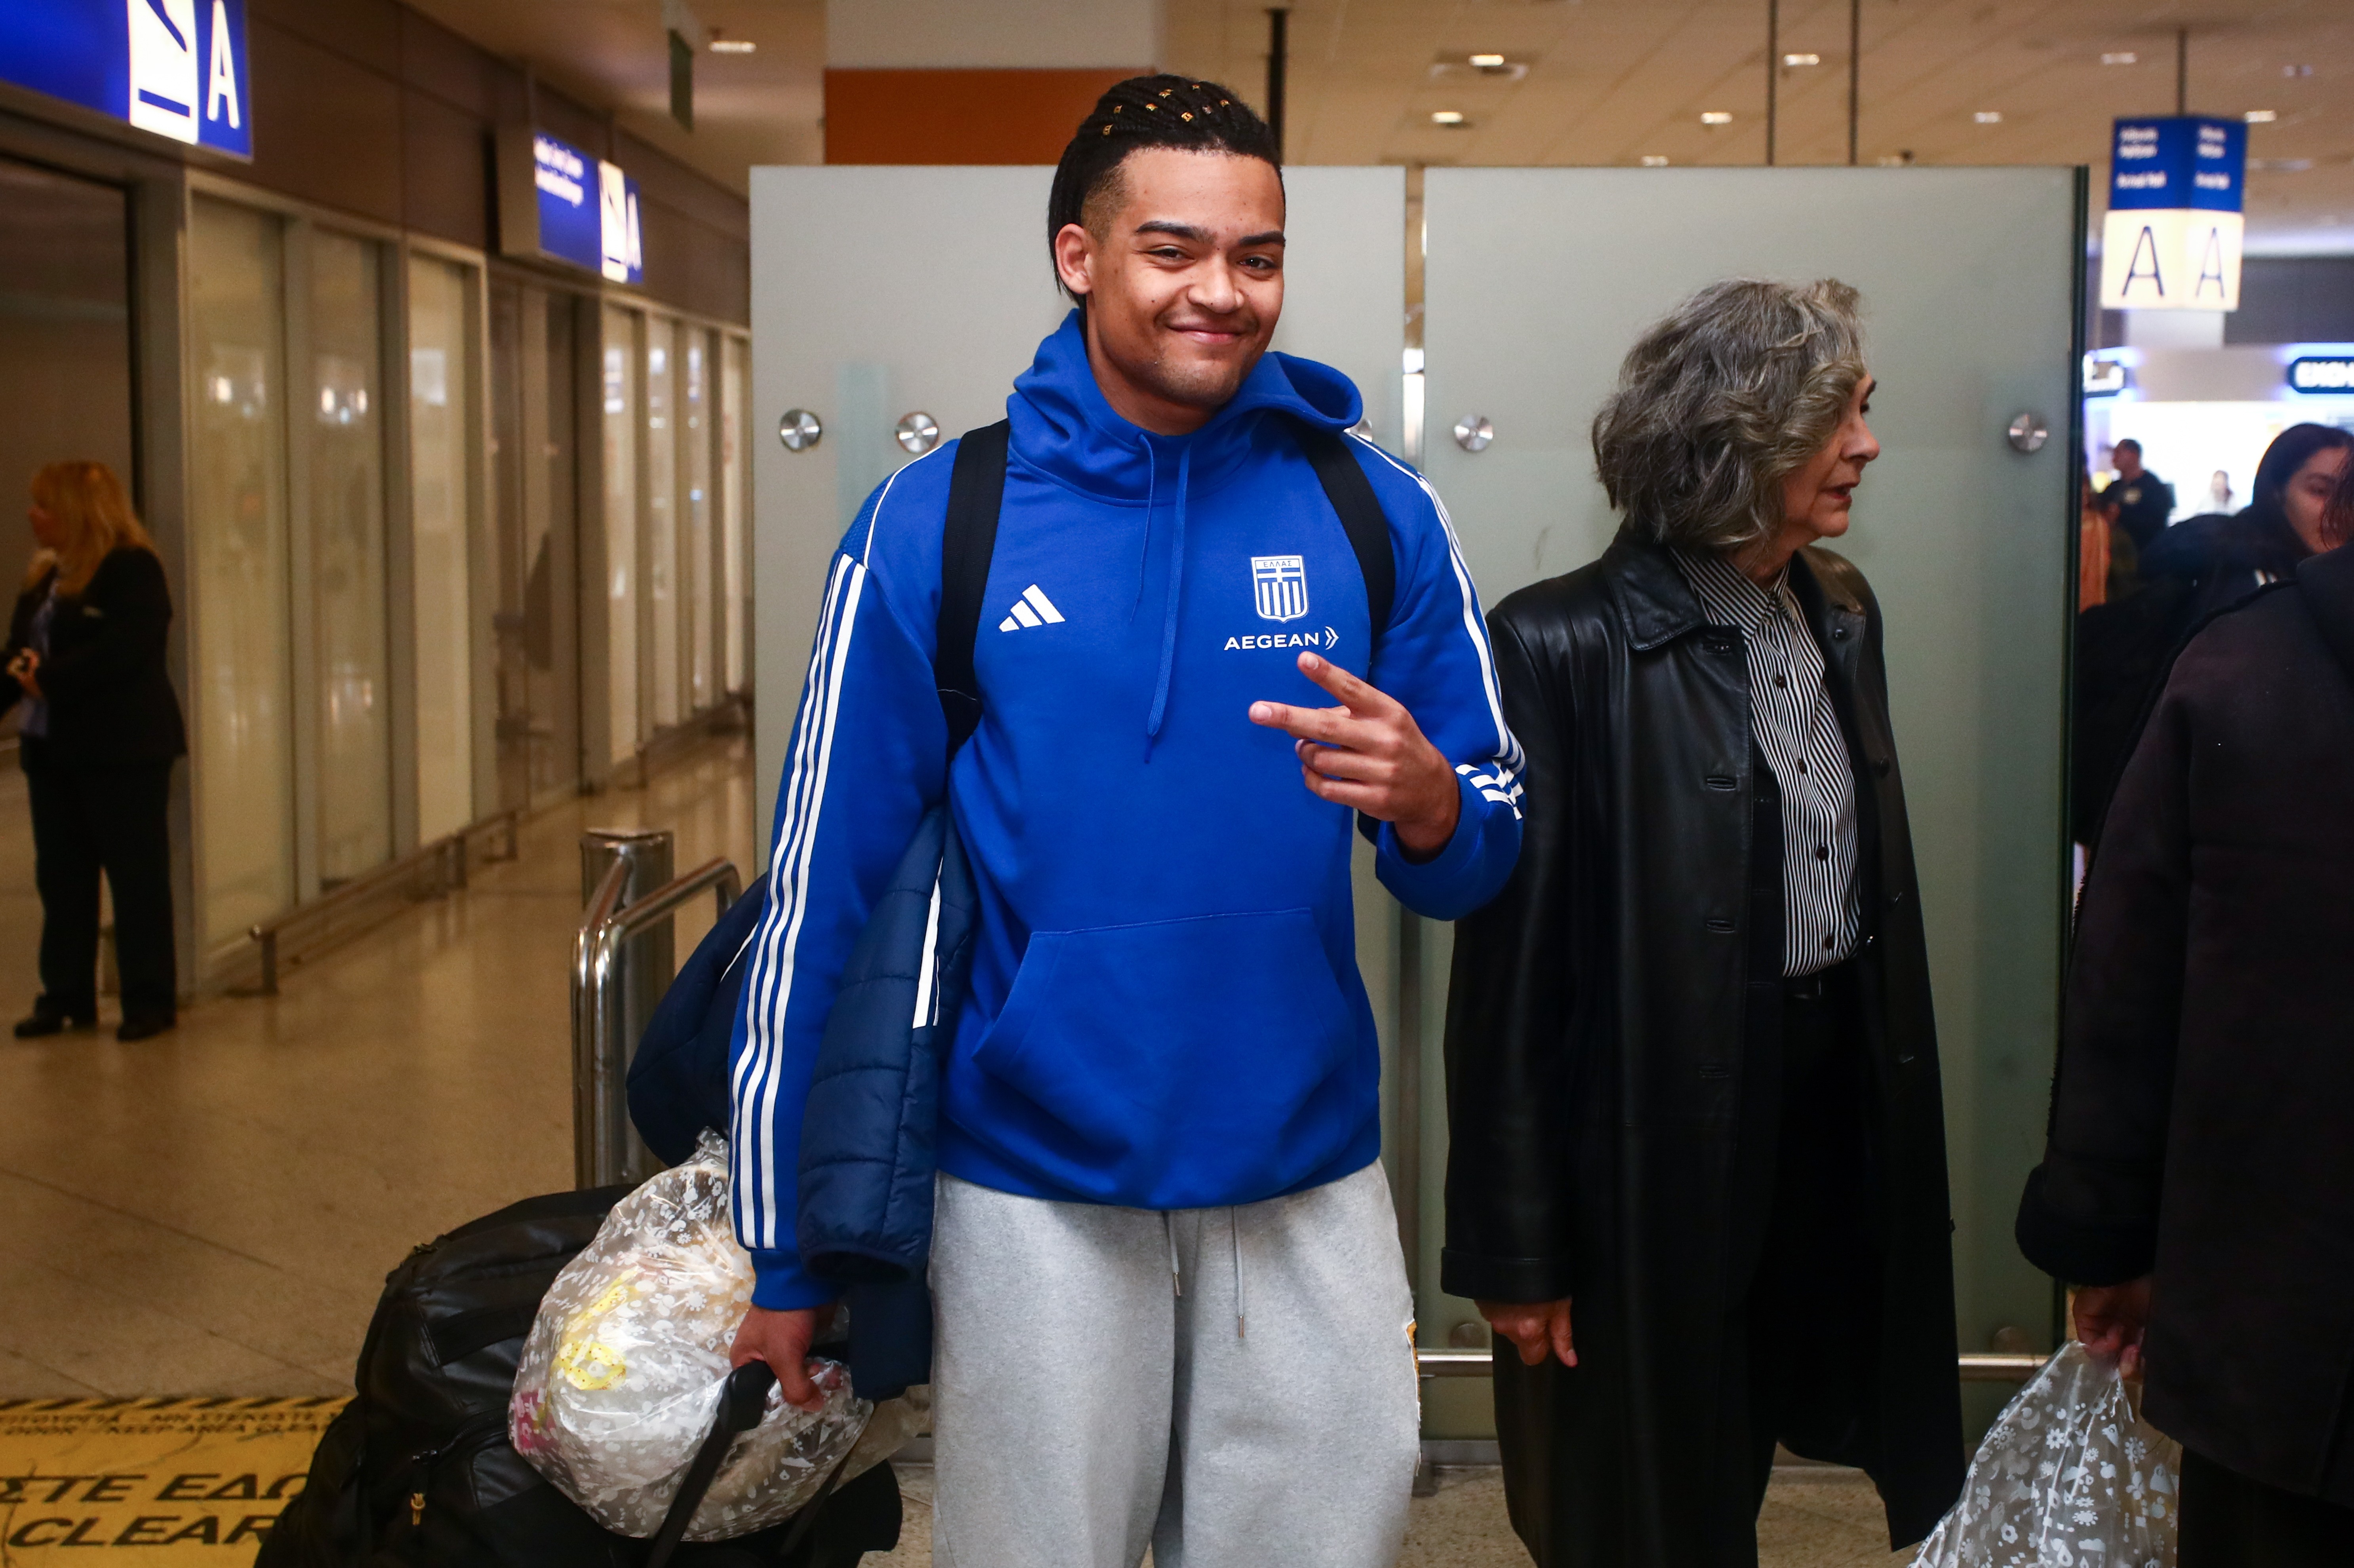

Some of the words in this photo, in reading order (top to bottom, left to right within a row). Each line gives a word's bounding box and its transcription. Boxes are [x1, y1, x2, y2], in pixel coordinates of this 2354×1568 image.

[207, 0, 240, 129] A
[2122, 225, 2165, 297] A
[2195, 226, 2225, 298] A
[1224, 632, 1319, 651] AEGEAN
